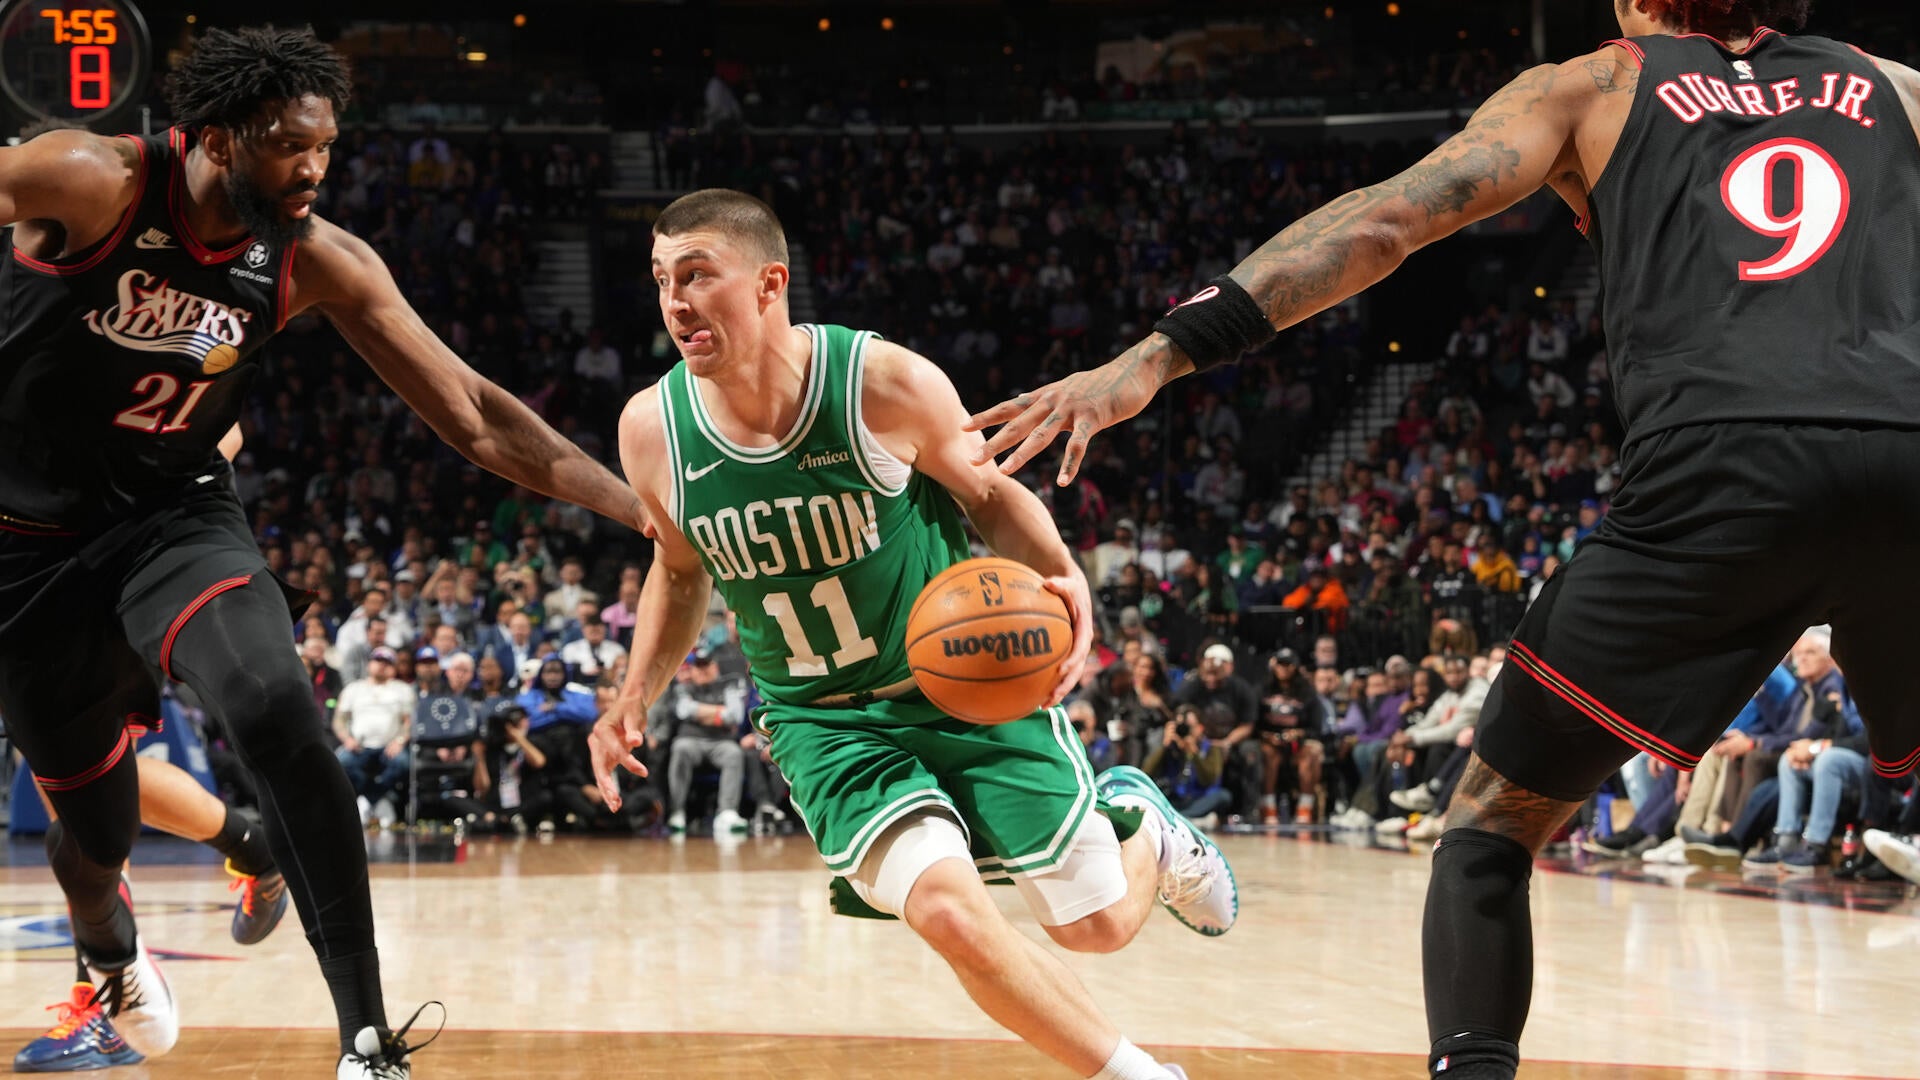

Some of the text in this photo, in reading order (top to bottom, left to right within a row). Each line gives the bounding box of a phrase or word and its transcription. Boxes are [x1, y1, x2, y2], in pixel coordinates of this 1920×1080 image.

[40, 9, 117, 44] 7:55
[70, 45, 111, 109] 8
[1655, 72, 1876, 129] OUBRE JR.
[143, 227, 172, 247] NIKE
[1720, 136, 1850, 281] 9
[230, 267, 273, 285] crypto.com
[112, 371, 216, 434] 21
[797, 450, 849, 471] Amica
[688, 490, 881, 581] BOSTON
[761, 575, 879, 678] 11
[941, 626, 1053, 662] Wilson
